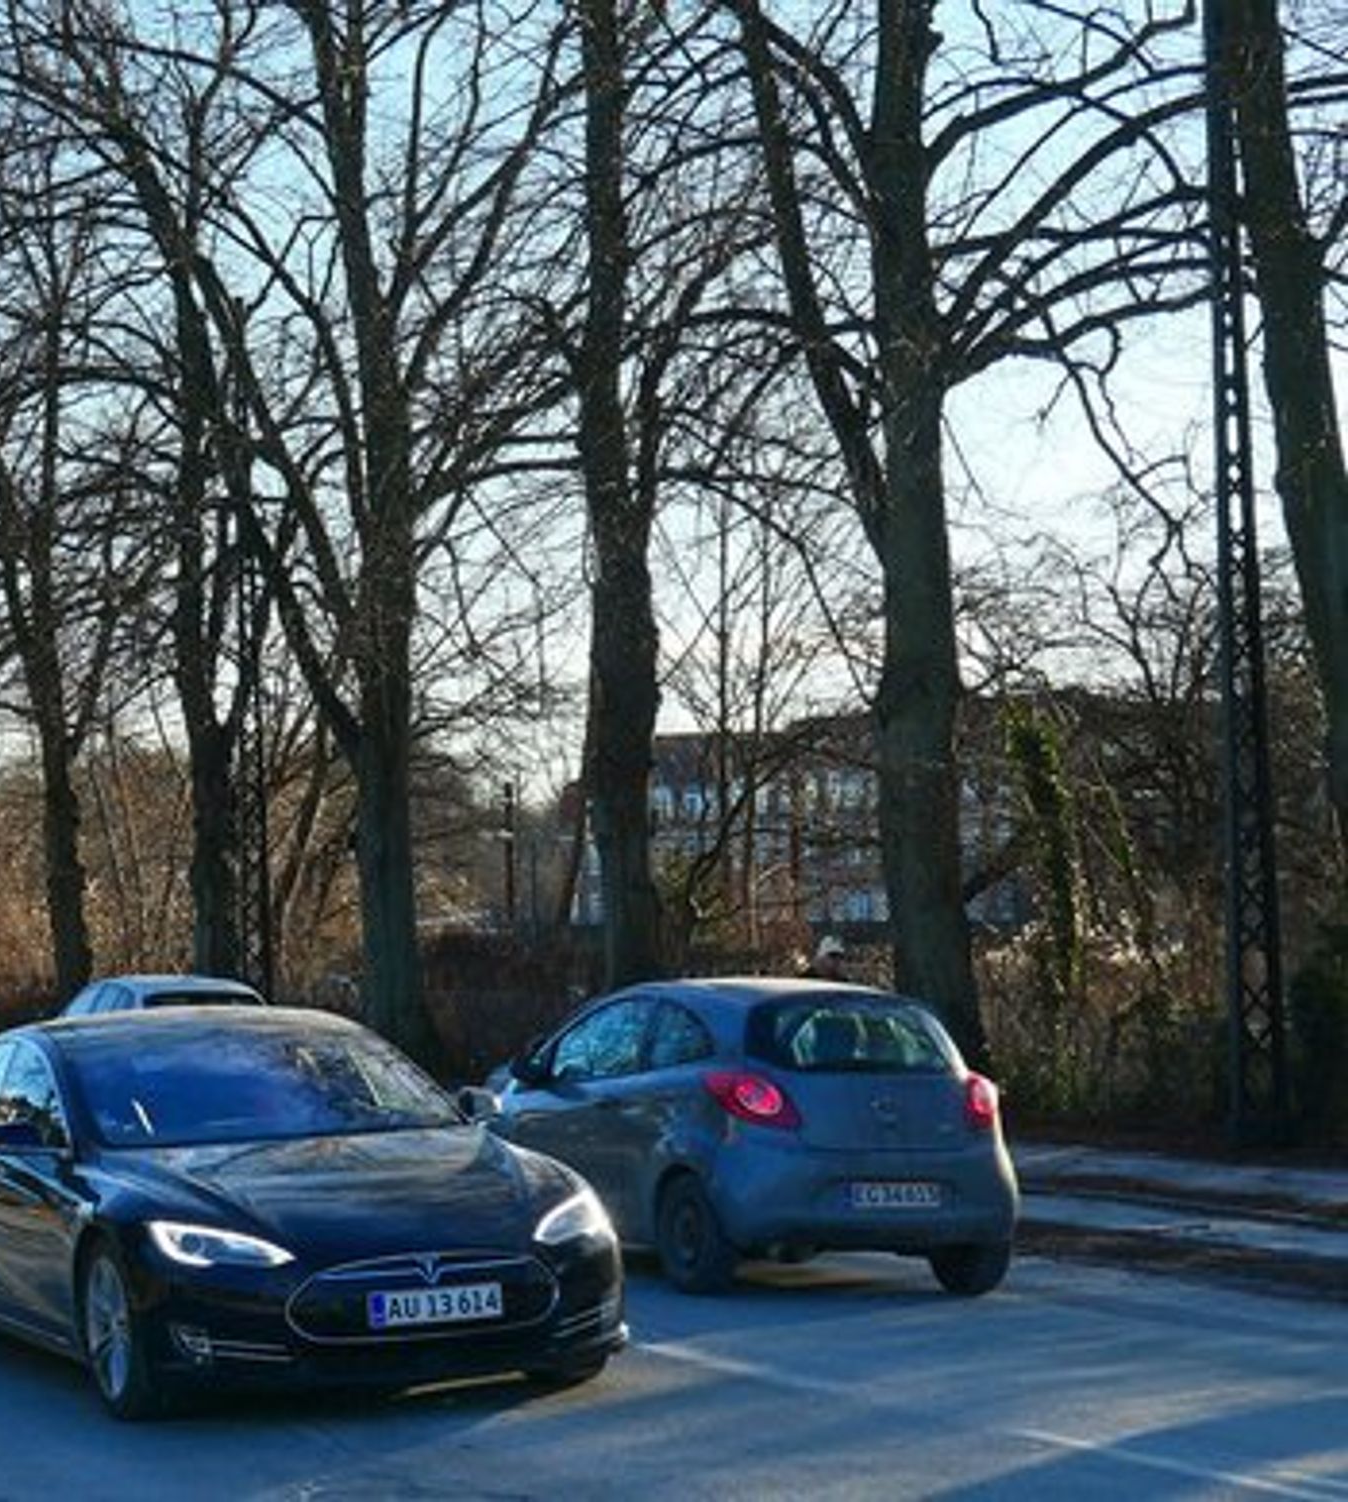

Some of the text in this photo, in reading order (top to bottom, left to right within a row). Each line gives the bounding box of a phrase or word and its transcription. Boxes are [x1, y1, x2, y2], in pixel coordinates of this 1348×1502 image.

[389, 1290, 499, 1319] AU 13 614
